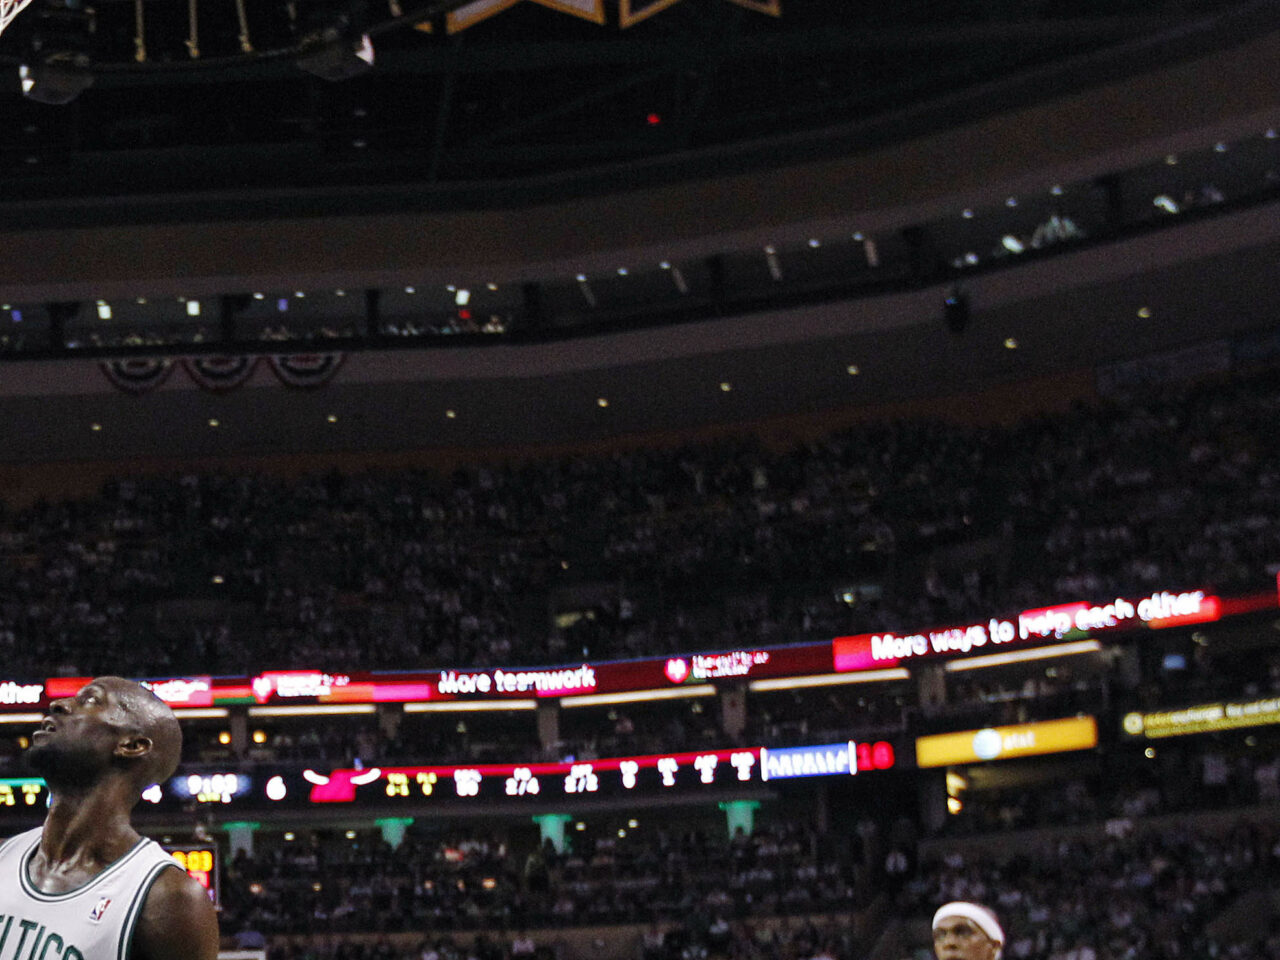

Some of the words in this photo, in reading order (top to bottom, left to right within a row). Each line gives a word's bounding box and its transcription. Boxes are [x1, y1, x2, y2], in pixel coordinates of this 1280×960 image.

[871, 634, 927, 660] More
[930, 625, 987, 652] ways
[989, 618, 1014, 644] to
[1137, 591, 1204, 621] other
[438, 670, 491, 693] More
